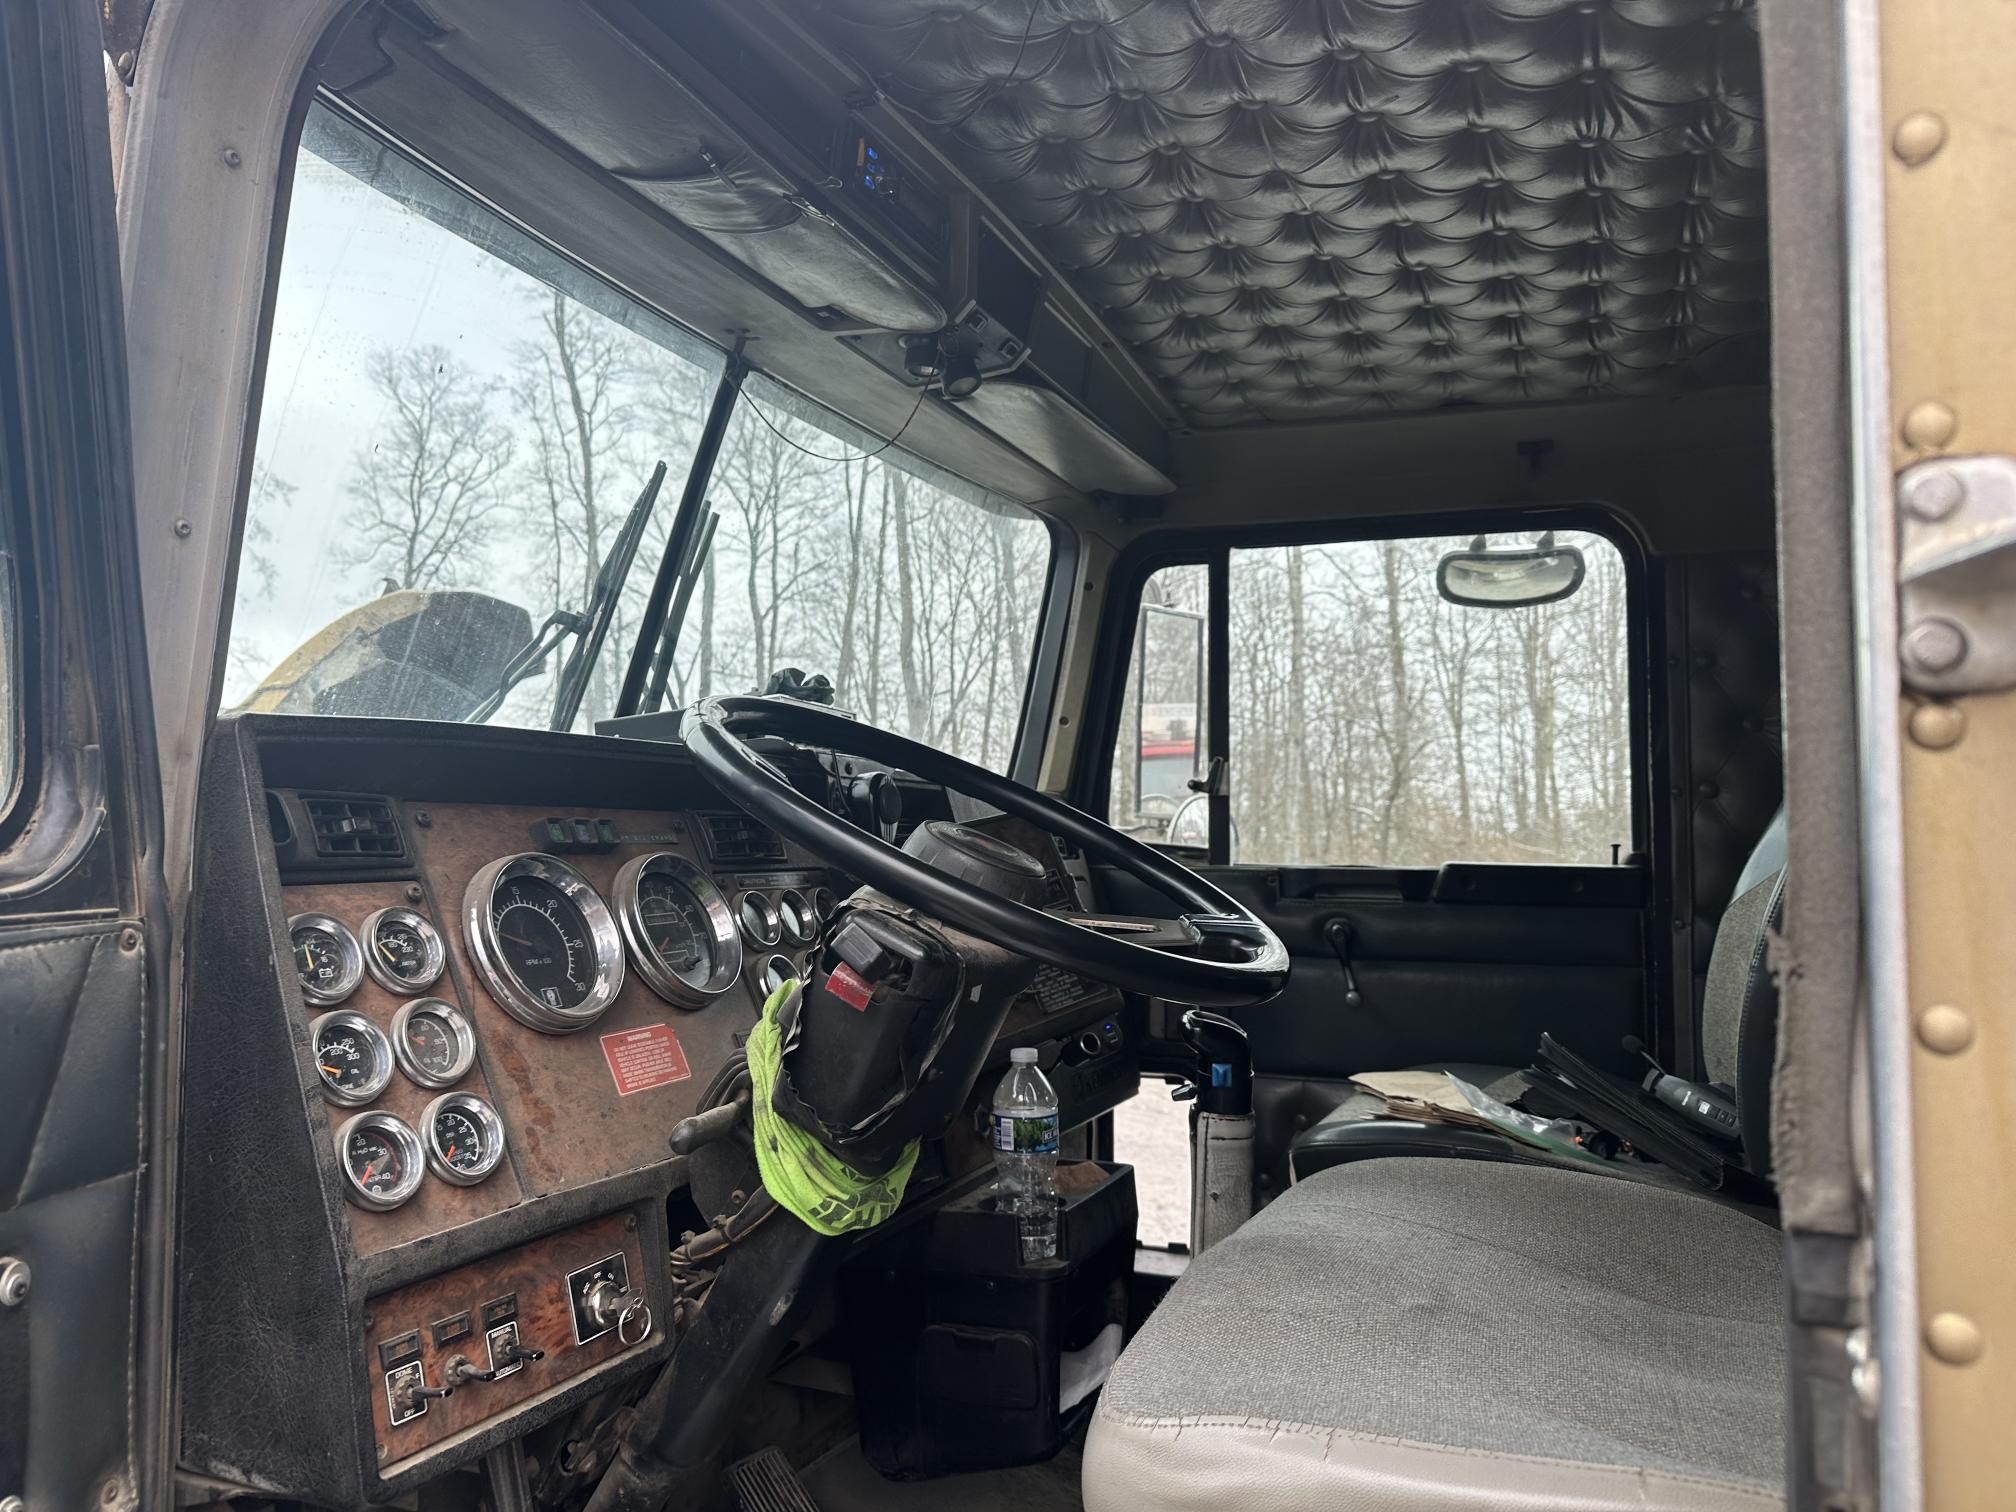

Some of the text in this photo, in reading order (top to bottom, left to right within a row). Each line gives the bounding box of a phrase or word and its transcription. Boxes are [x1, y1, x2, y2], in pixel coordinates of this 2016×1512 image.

[341, 1037, 355, 1046] 250
[329, 1047, 344, 1056] 200
[346, 1052, 360, 1061] 300
[356, 1138, 367, 1147] 20
[377, 1147, 388, 1156] 30
[395, 1366, 414, 1379] DOME
